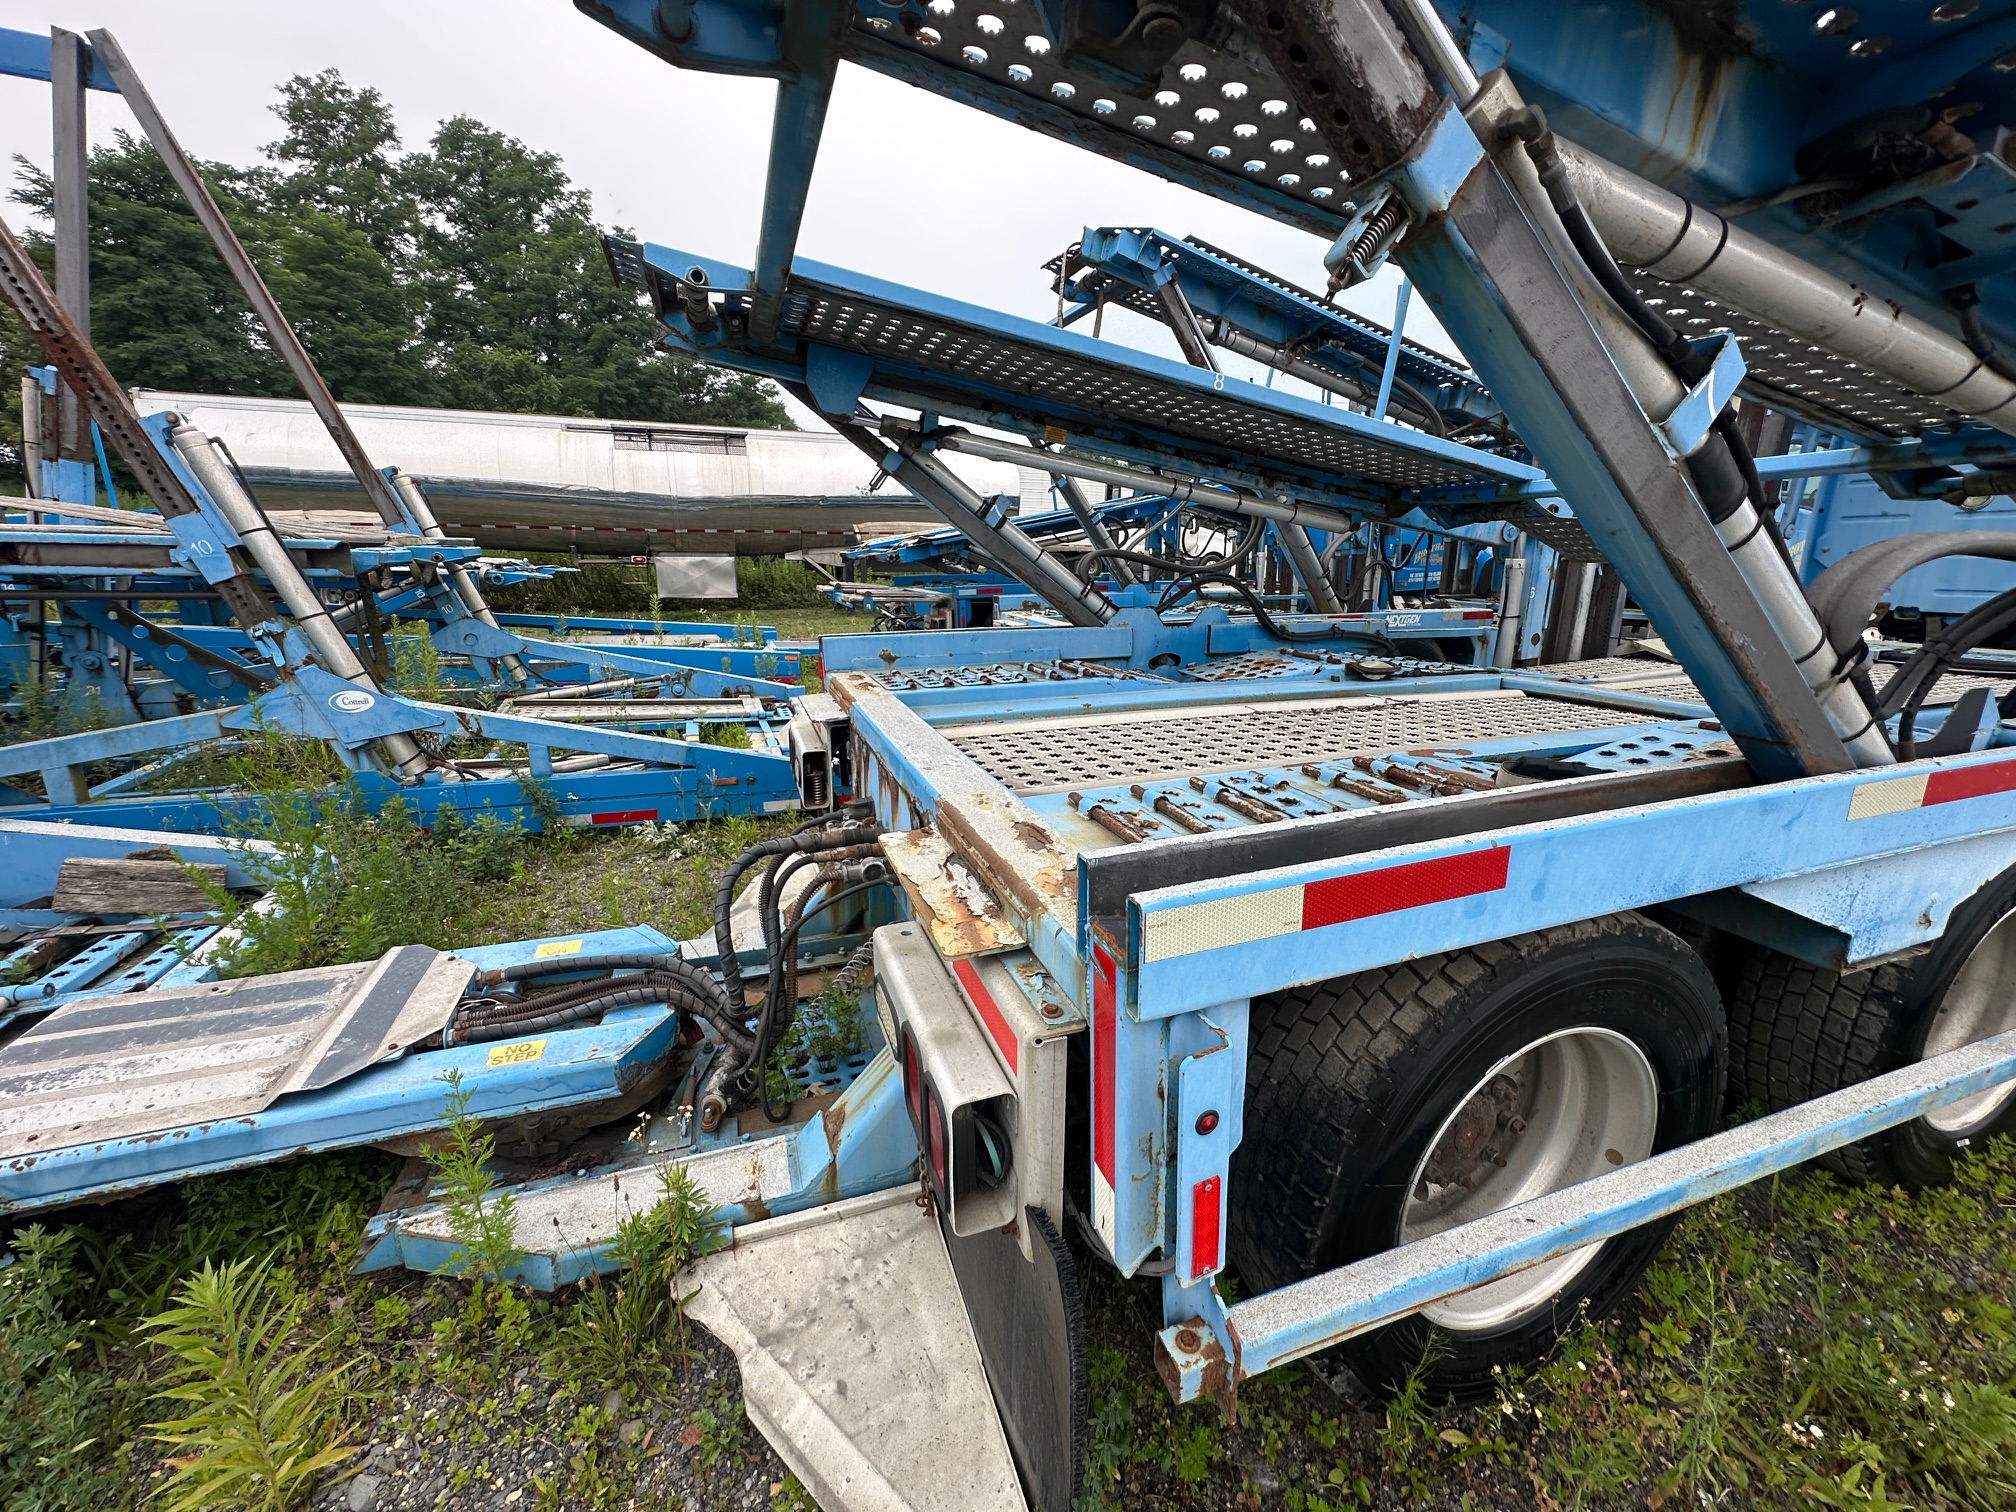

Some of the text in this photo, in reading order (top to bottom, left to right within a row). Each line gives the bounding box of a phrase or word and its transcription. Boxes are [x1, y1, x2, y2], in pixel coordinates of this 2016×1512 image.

[1213, 372, 1225, 391] 8
[1692, 368, 1718, 421] 7
[190, 539, 213, 557] 10
[414, 588, 426, 599] 10
[441, 604, 454, 615] 10
[341, 696, 370, 706] Cottrell
[505, 1043, 532, 1054] NO
[490, 1050, 538, 1066] STEP
